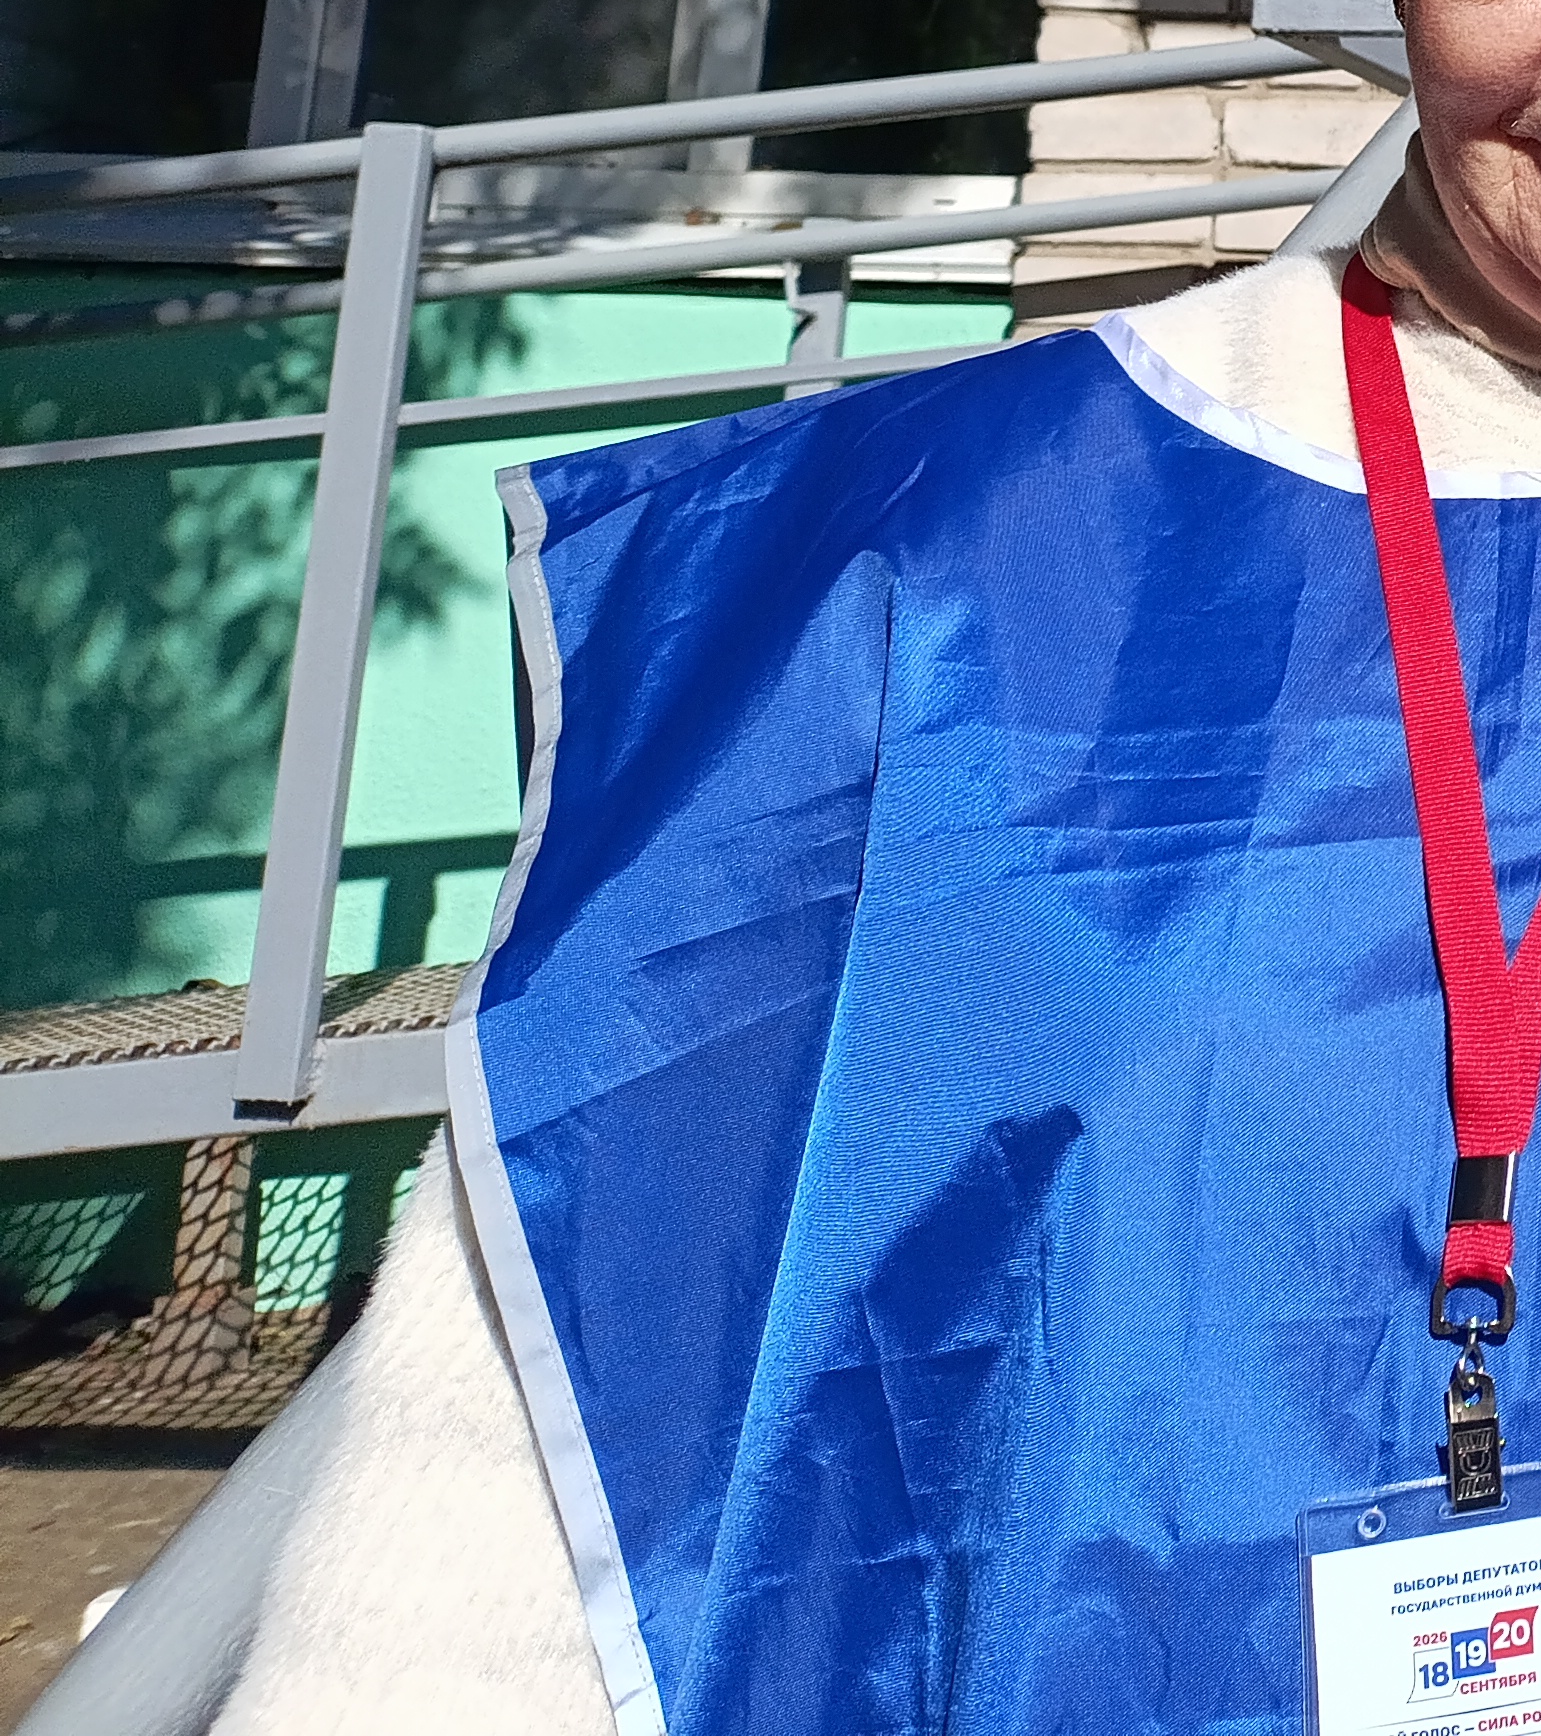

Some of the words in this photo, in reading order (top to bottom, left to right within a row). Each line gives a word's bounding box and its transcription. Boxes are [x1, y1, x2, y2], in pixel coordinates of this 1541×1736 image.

[1393, 1573, 1459, 1595] ВЫБОРЫ
[1391, 1584, 1513, 1616] ГОСУДАРСТВЕННОЙ
[1412, 1630, 1448, 1648] 2026
[1418, 1661, 1450, 1690] 18
[1454, 1638, 1487, 1670] 19
[1492, 1618, 1531, 1651] 20
[1459, 1671, 1538, 1696] СЕНТЯБРЯ
[1478, 1714, 1519, 1733] СИЛА
